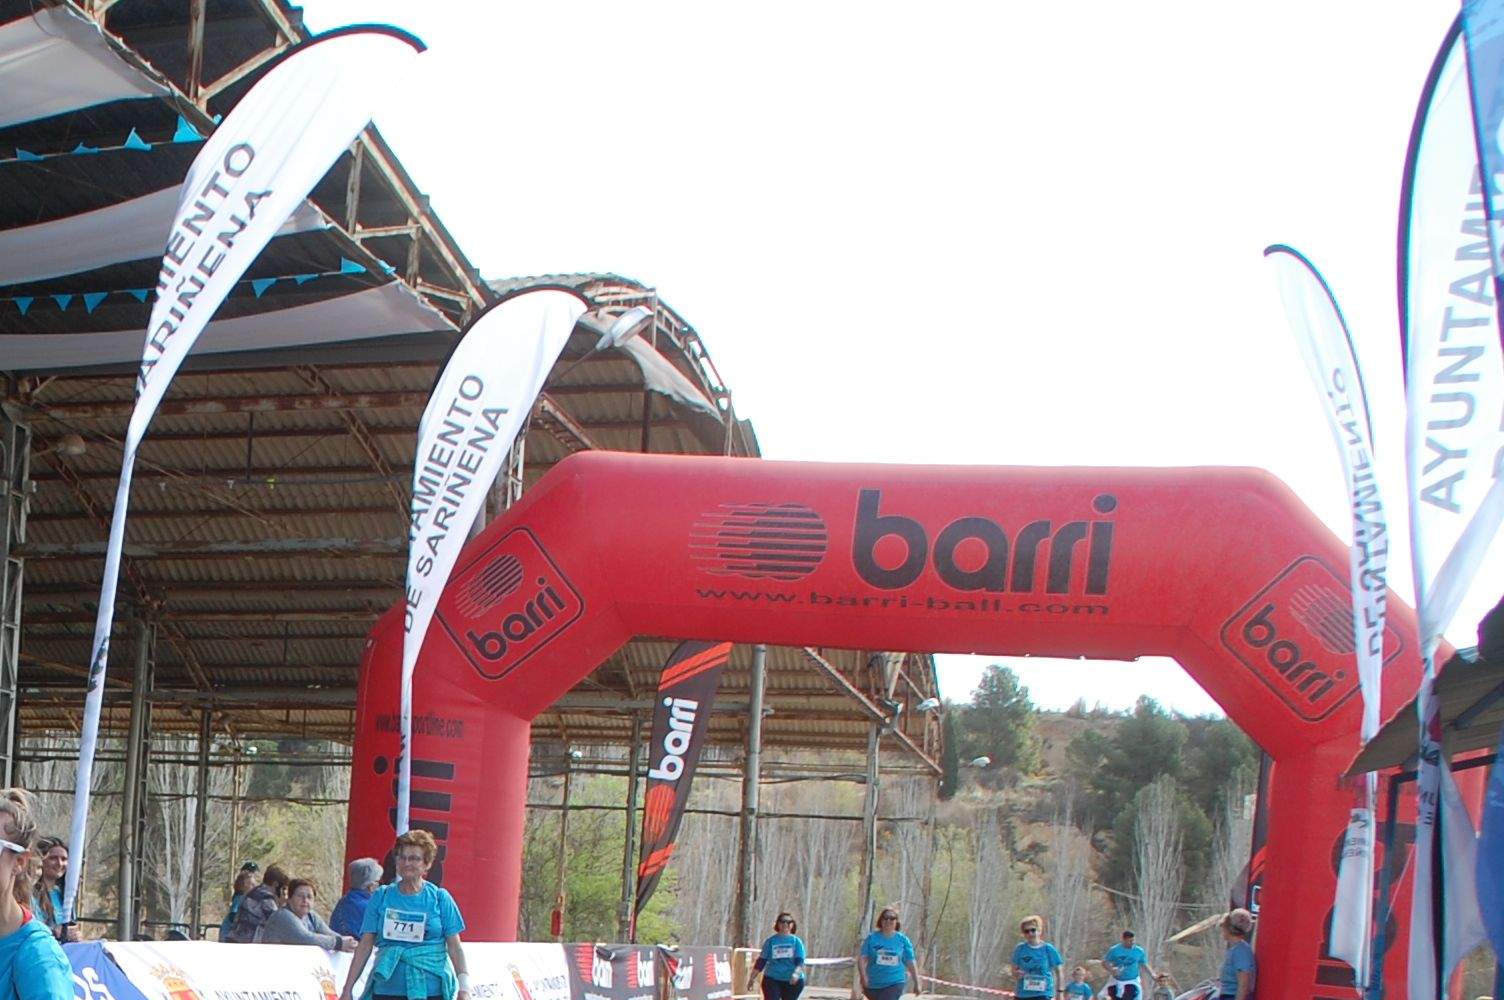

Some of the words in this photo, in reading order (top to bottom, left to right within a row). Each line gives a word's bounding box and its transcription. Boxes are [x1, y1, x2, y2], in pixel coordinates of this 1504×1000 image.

[852, 488, 1118, 596] barri
[466, 576, 566, 661] barri
[697, 588, 1110, 616] www.barri-ball.com
[1242, 603, 1346, 703] barri
[648, 696, 699, 781] barri
[393, 921, 415, 933] 771
